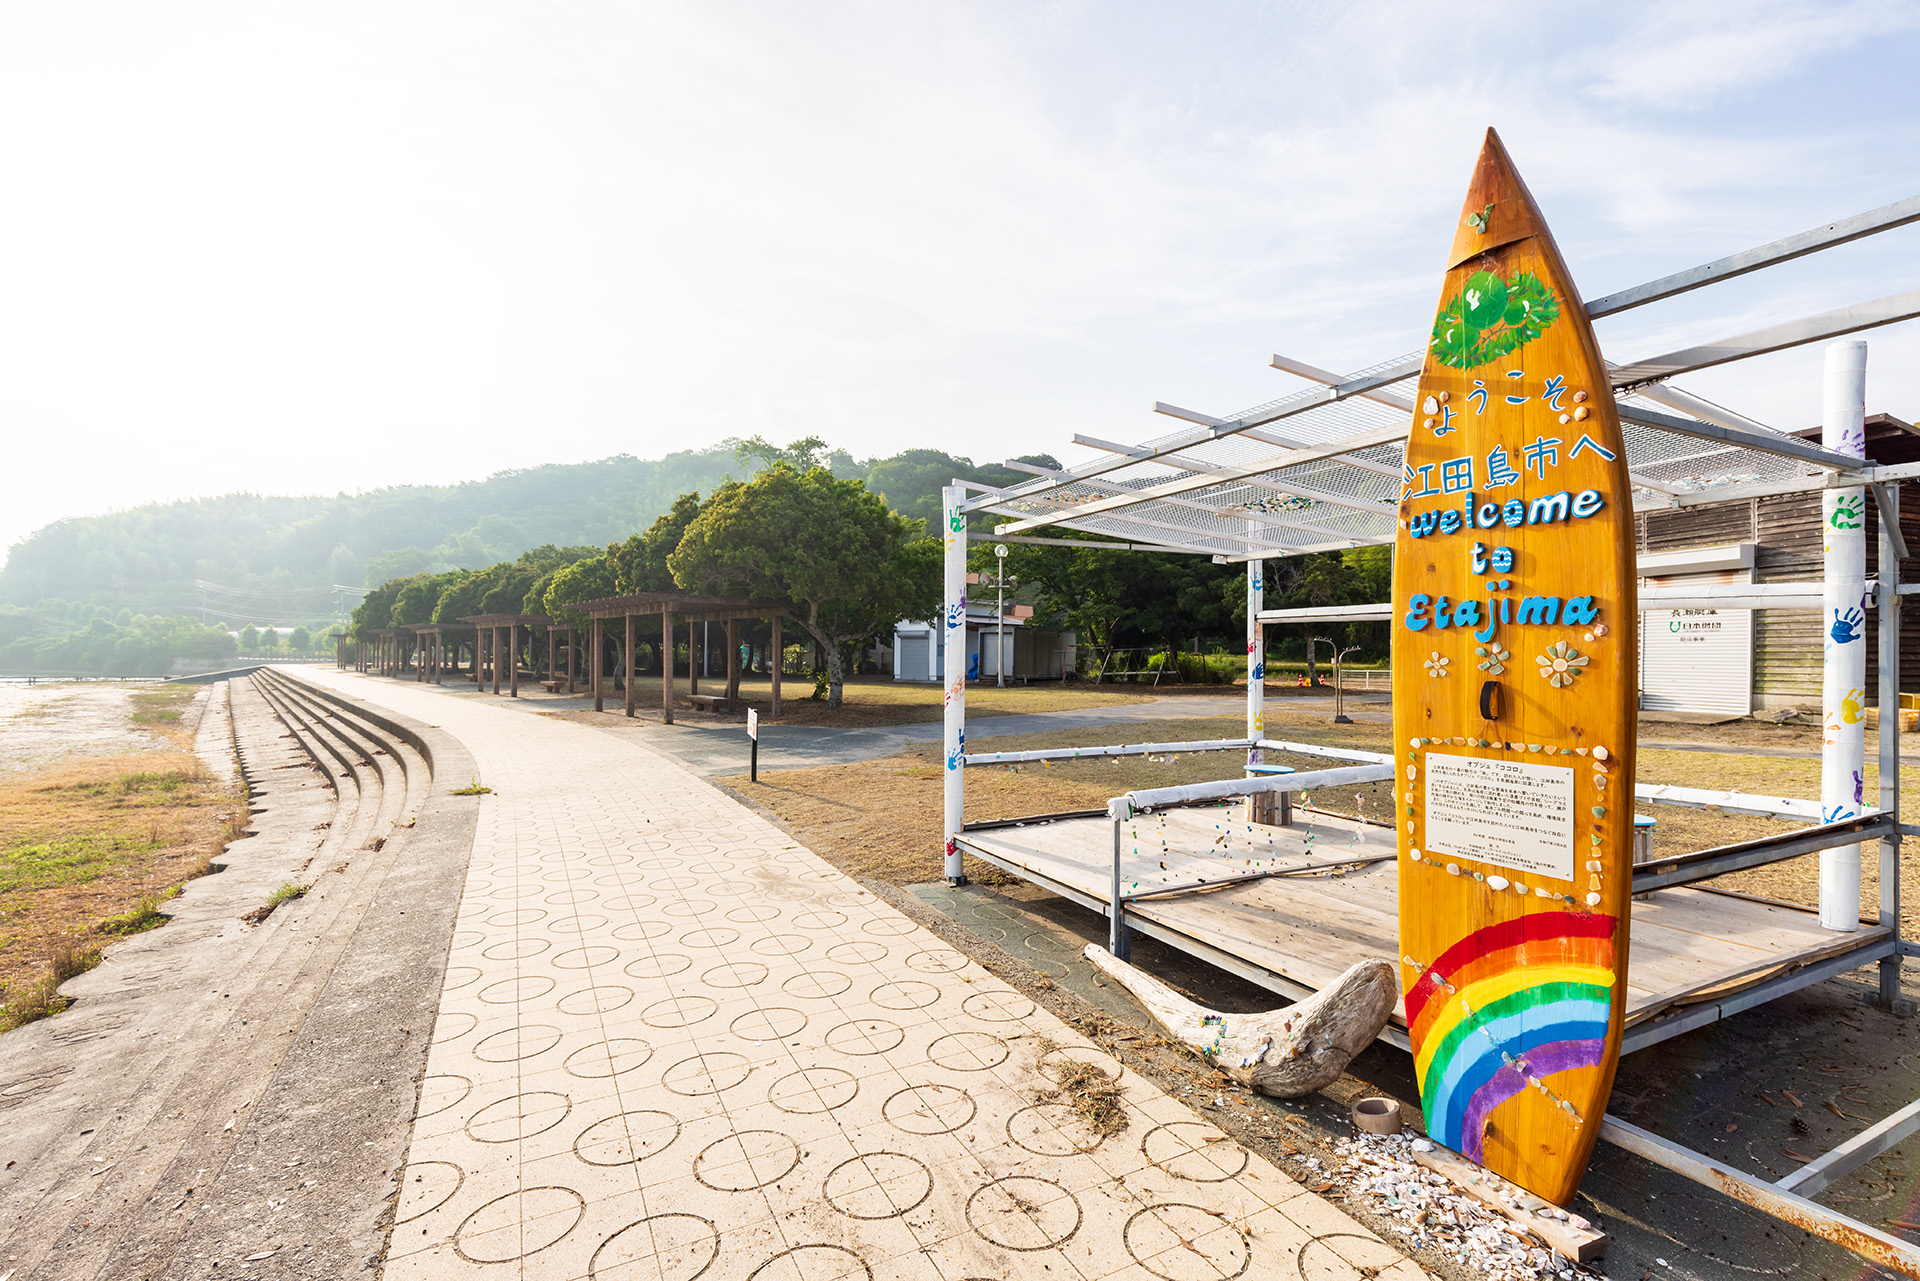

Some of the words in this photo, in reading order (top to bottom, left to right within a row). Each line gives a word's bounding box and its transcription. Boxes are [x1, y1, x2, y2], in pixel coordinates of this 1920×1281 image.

[1434, 370, 1568, 437] ようこそ
[1402, 433, 1616, 501] 江田島市へ
[1410, 490, 1605, 538] welcome
[1470, 542, 1514, 574] to
[1405, 580, 1600, 643] Etajima
